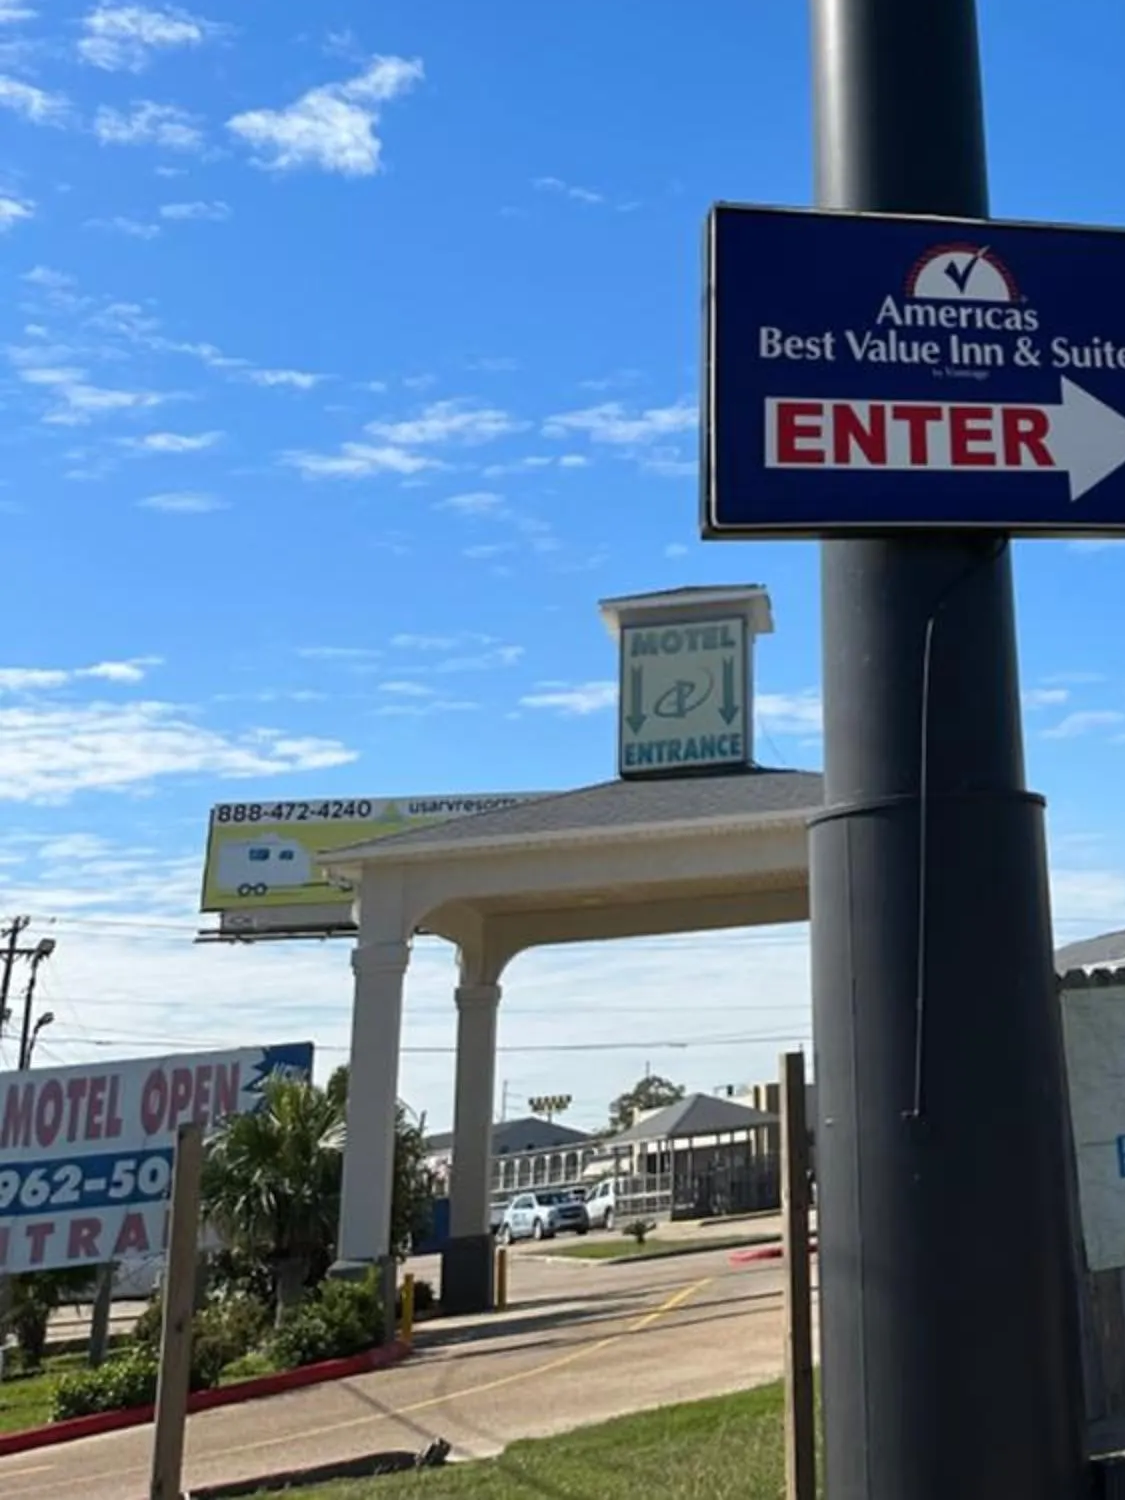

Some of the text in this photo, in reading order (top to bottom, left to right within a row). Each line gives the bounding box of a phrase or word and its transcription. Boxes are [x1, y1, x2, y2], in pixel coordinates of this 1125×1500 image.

[876, 295, 1039, 332] Americas
[759, 327, 835, 361] Best
[845, 330, 941, 365] Value
[951, 334, 1004, 367] Inn
[1013, 338, 1041, 368] &
[776, 401, 1056, 468] ENTER
[630, 625, 737, 657] MOTEL
[624, 732, 742, 767] ENTRANCE
[217, 800, 372, 823] 888-472-4240
[1, 1061, 241, 1150] MOTEL OPEN
[0, 1155, 170, 1208] 962-50
